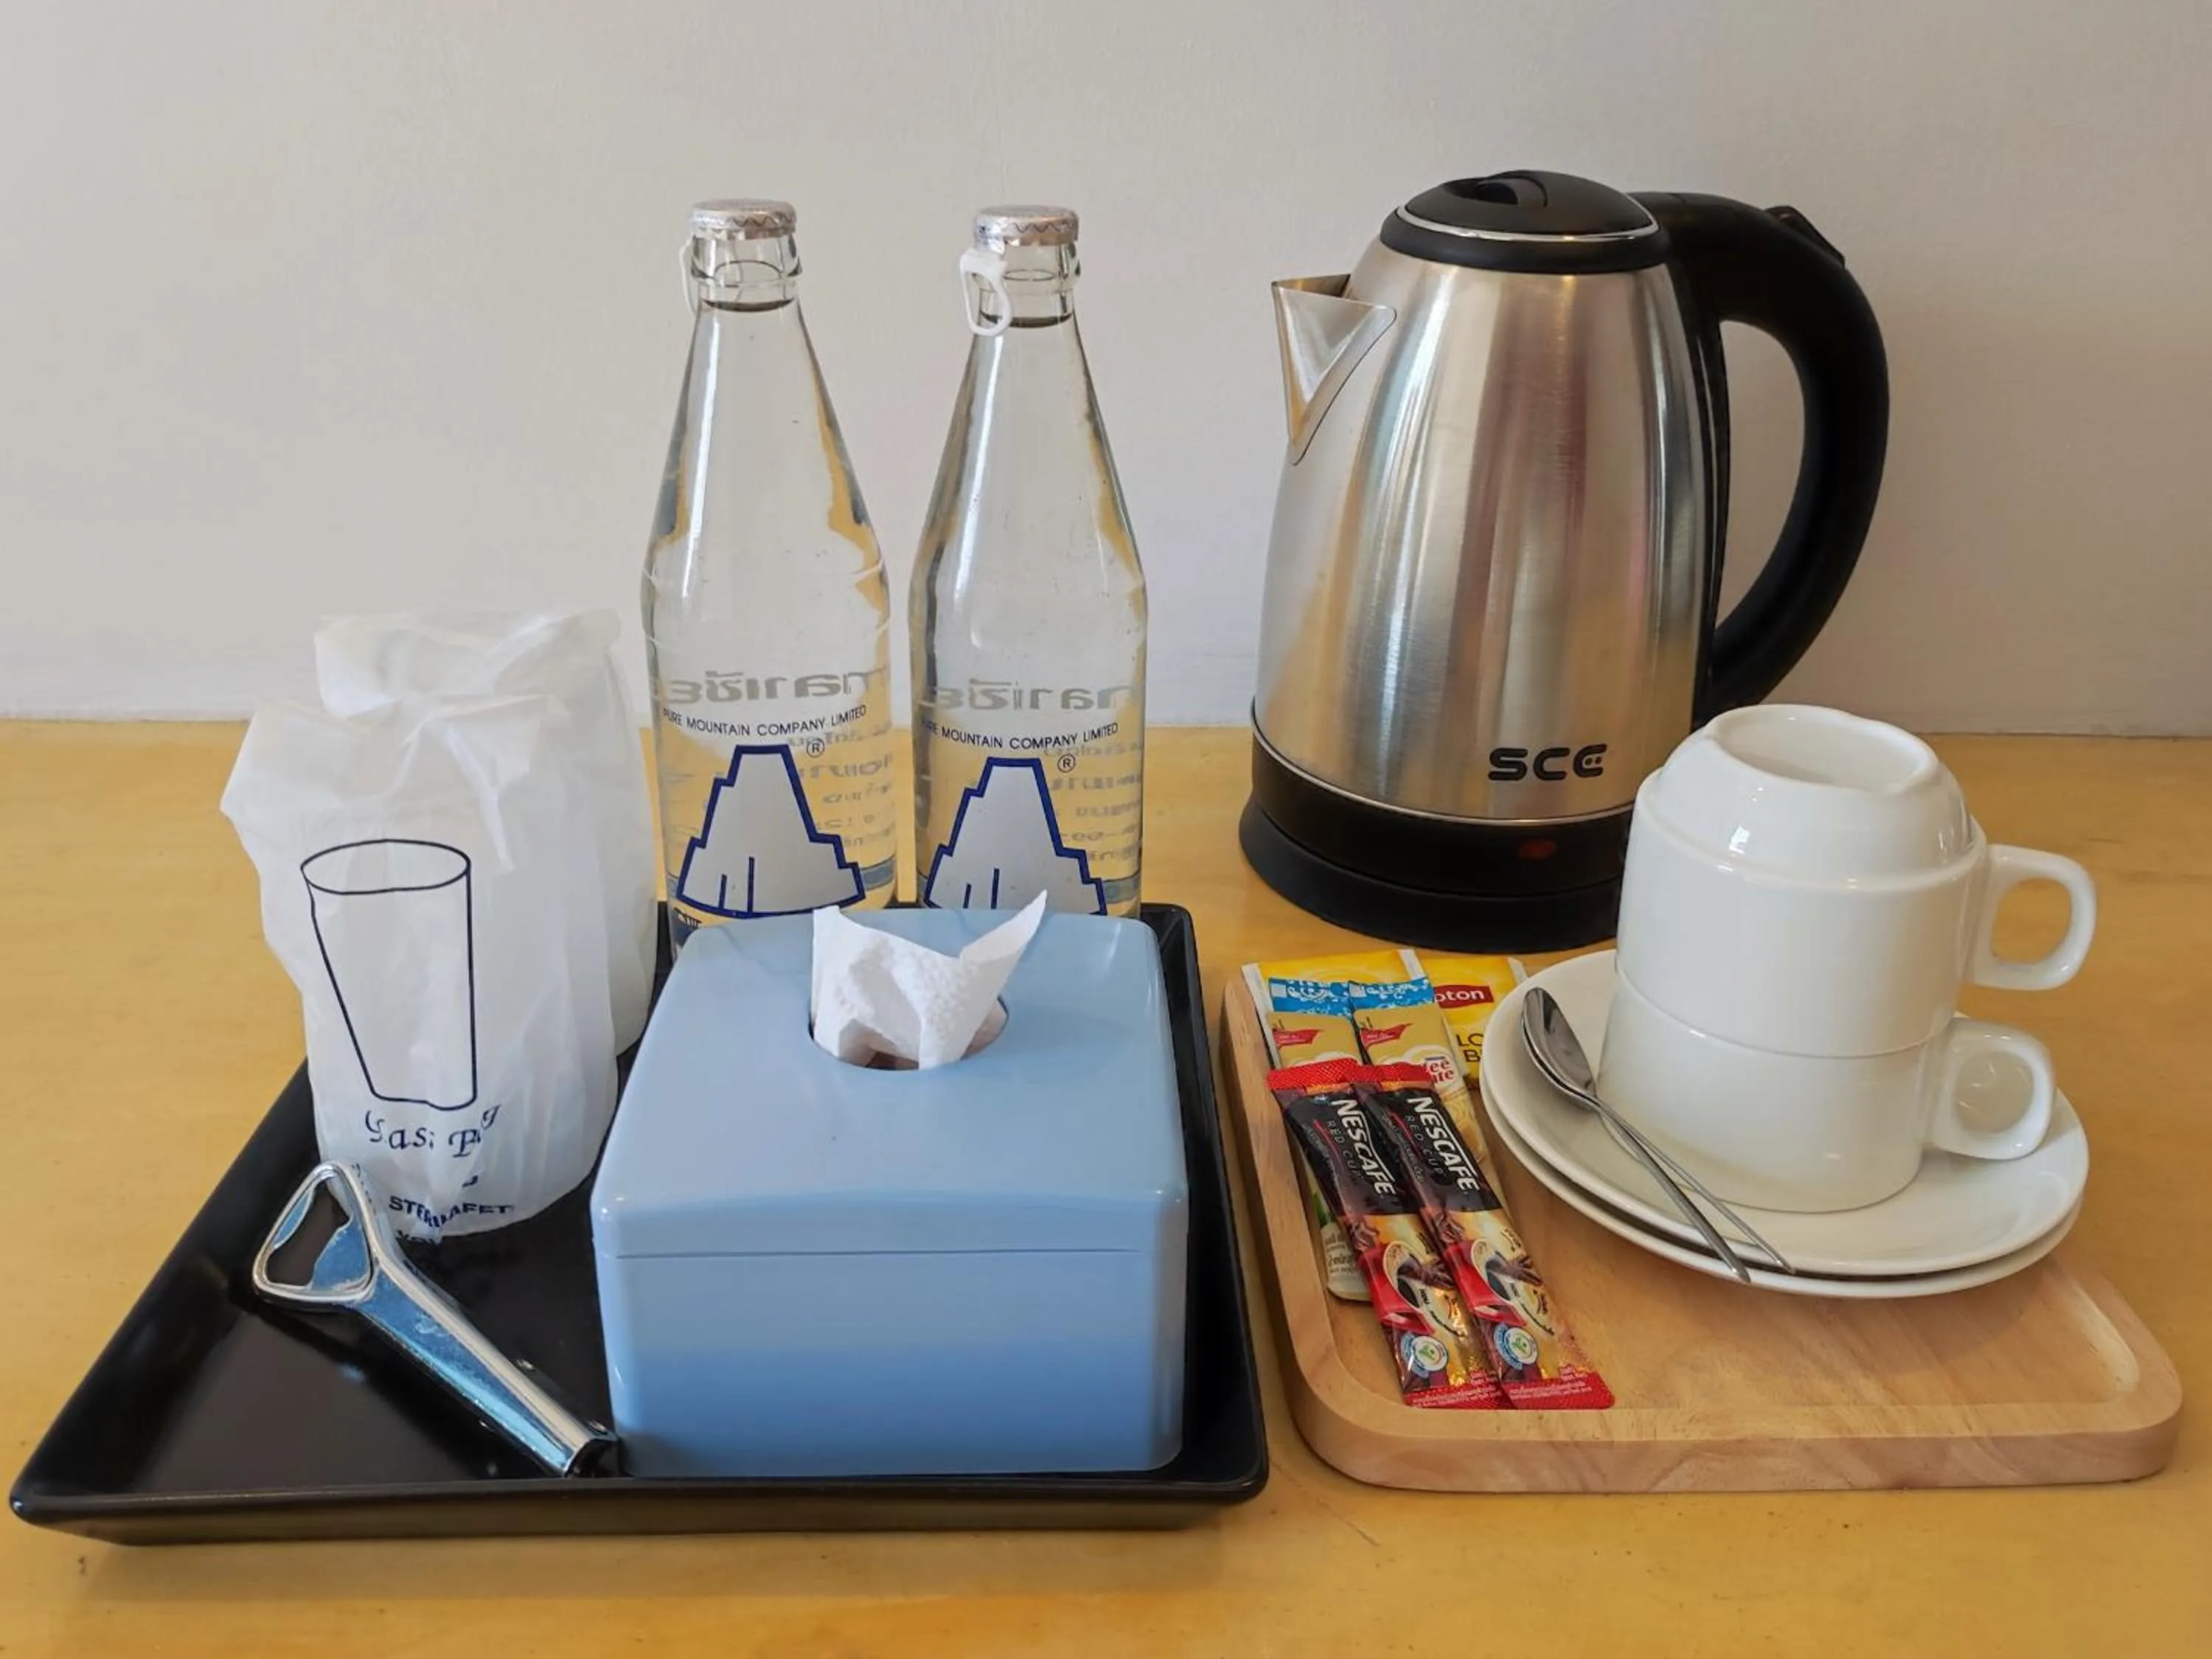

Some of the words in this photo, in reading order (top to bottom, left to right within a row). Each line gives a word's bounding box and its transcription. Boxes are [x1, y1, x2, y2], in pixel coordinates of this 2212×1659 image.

[686, 717, 750, 737] MOUNTAIN
[757, 717, 825, 736] COMPANY
[831, 704, 866, 726] LIMITED
[942, 726, 1003, 748] MOUNTAIN
[1009, 733, 1078, 750] COMPANY
[1083, 722, 1119, 742] LIMITED
